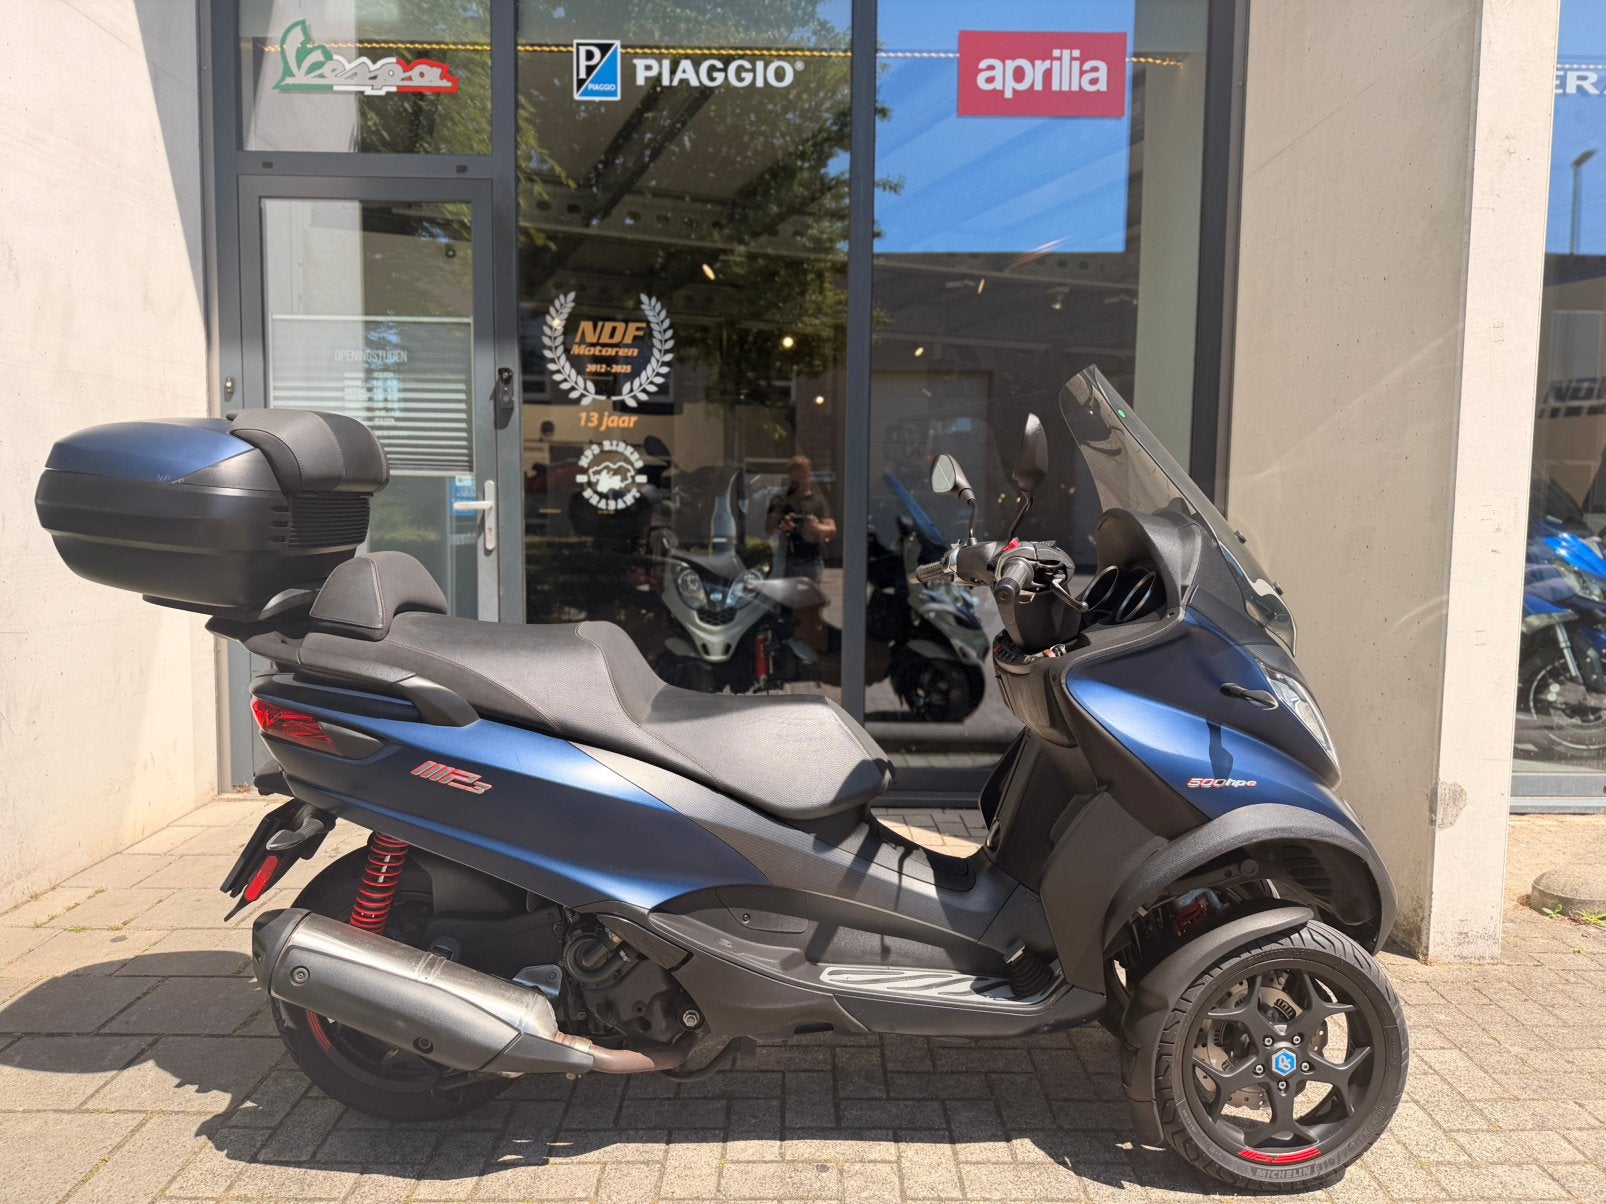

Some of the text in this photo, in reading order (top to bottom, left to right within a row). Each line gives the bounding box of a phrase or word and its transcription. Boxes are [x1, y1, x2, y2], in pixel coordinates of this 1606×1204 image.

[272, 19, 459, 95] Vespa
[632, 58, 795, 88] PIAGGIO
[976, 49, 1108, 99] aprilia
[587, 82, 616, 92] PIAGGIO
[575, 320, 647, 344] NDF
[570, 344, 639, 357] Motoren
[579, 411, 639, 432] 13 jaar
[1255, 1165, 1312, 1179] MICHELIN
